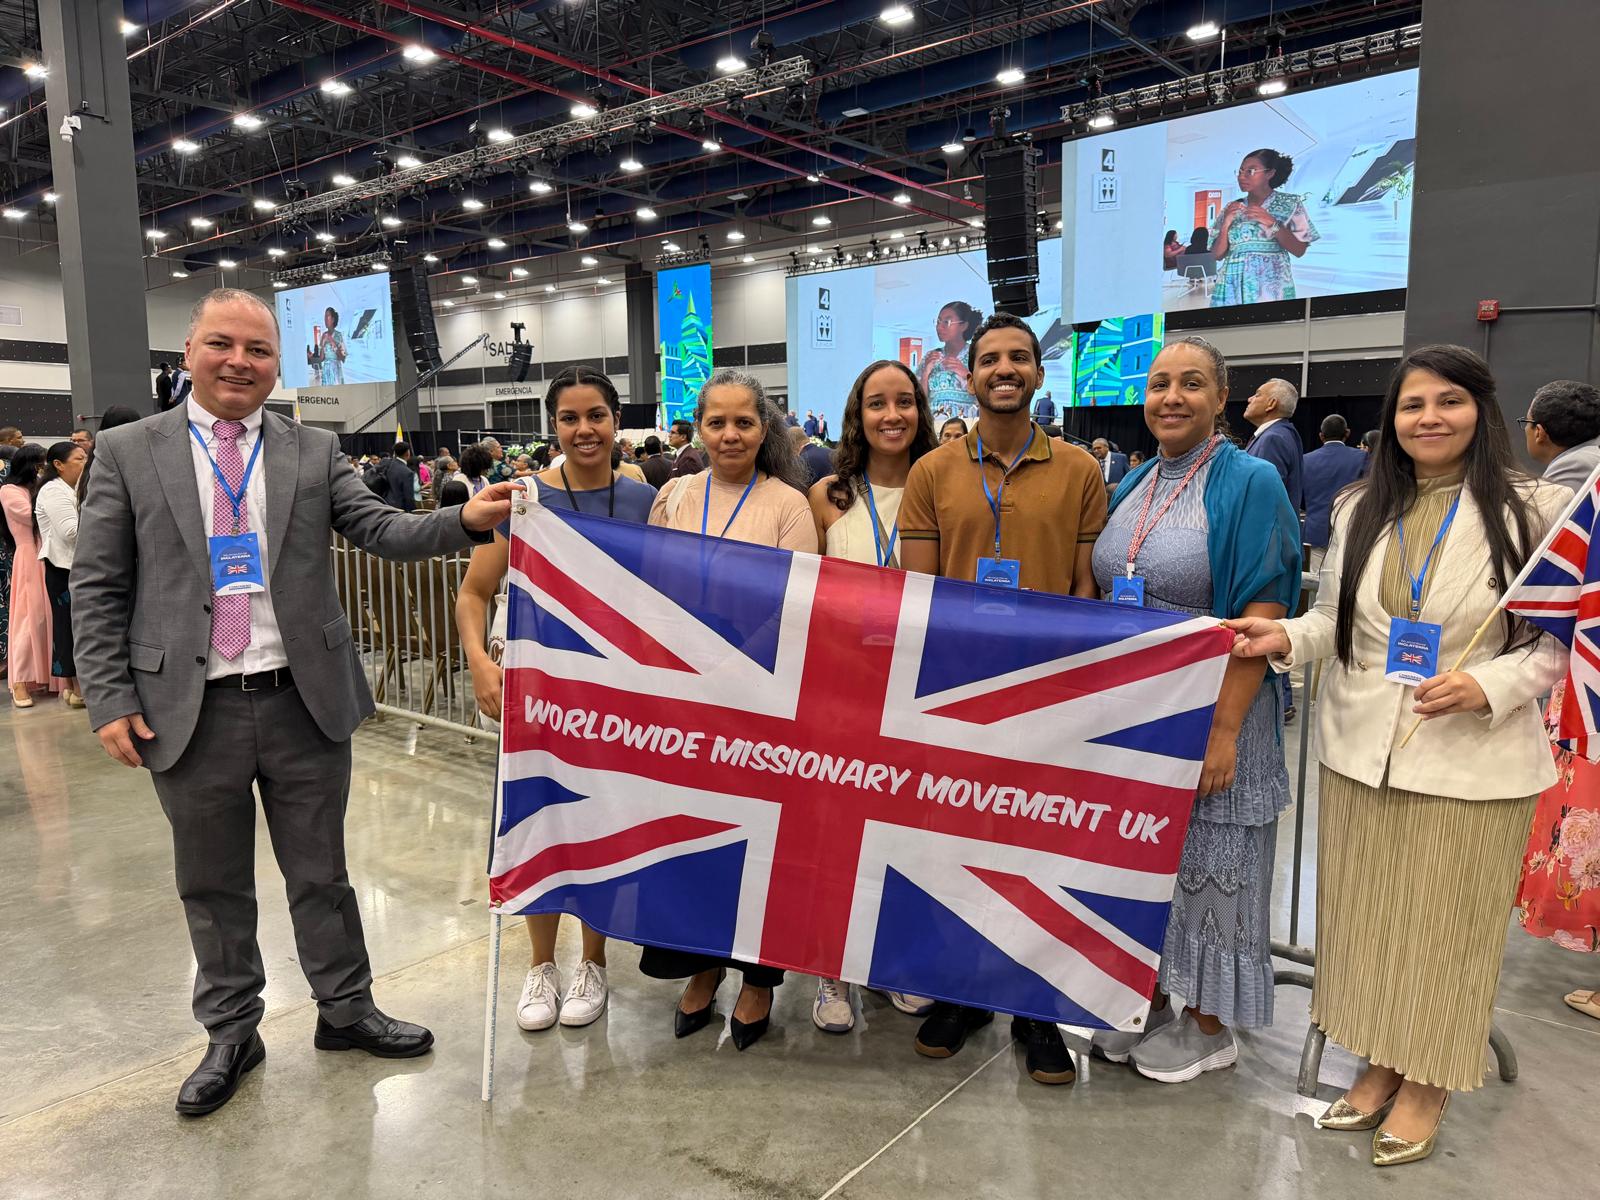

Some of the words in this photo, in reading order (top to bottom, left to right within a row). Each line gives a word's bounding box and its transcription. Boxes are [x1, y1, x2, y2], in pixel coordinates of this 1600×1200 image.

[1103, 151, 1114, 170] 4
[820, 290, 830, 309] 4
[495, 386, 532, 396] EMERGENCIA
[524, 695, 705, 759] WORLDWIDE
[710, 735, 911, 796] MISSIONARY
[916, 772, 1112, 833] MOVEMENT
[1118, 809, 1170, 845] UK
